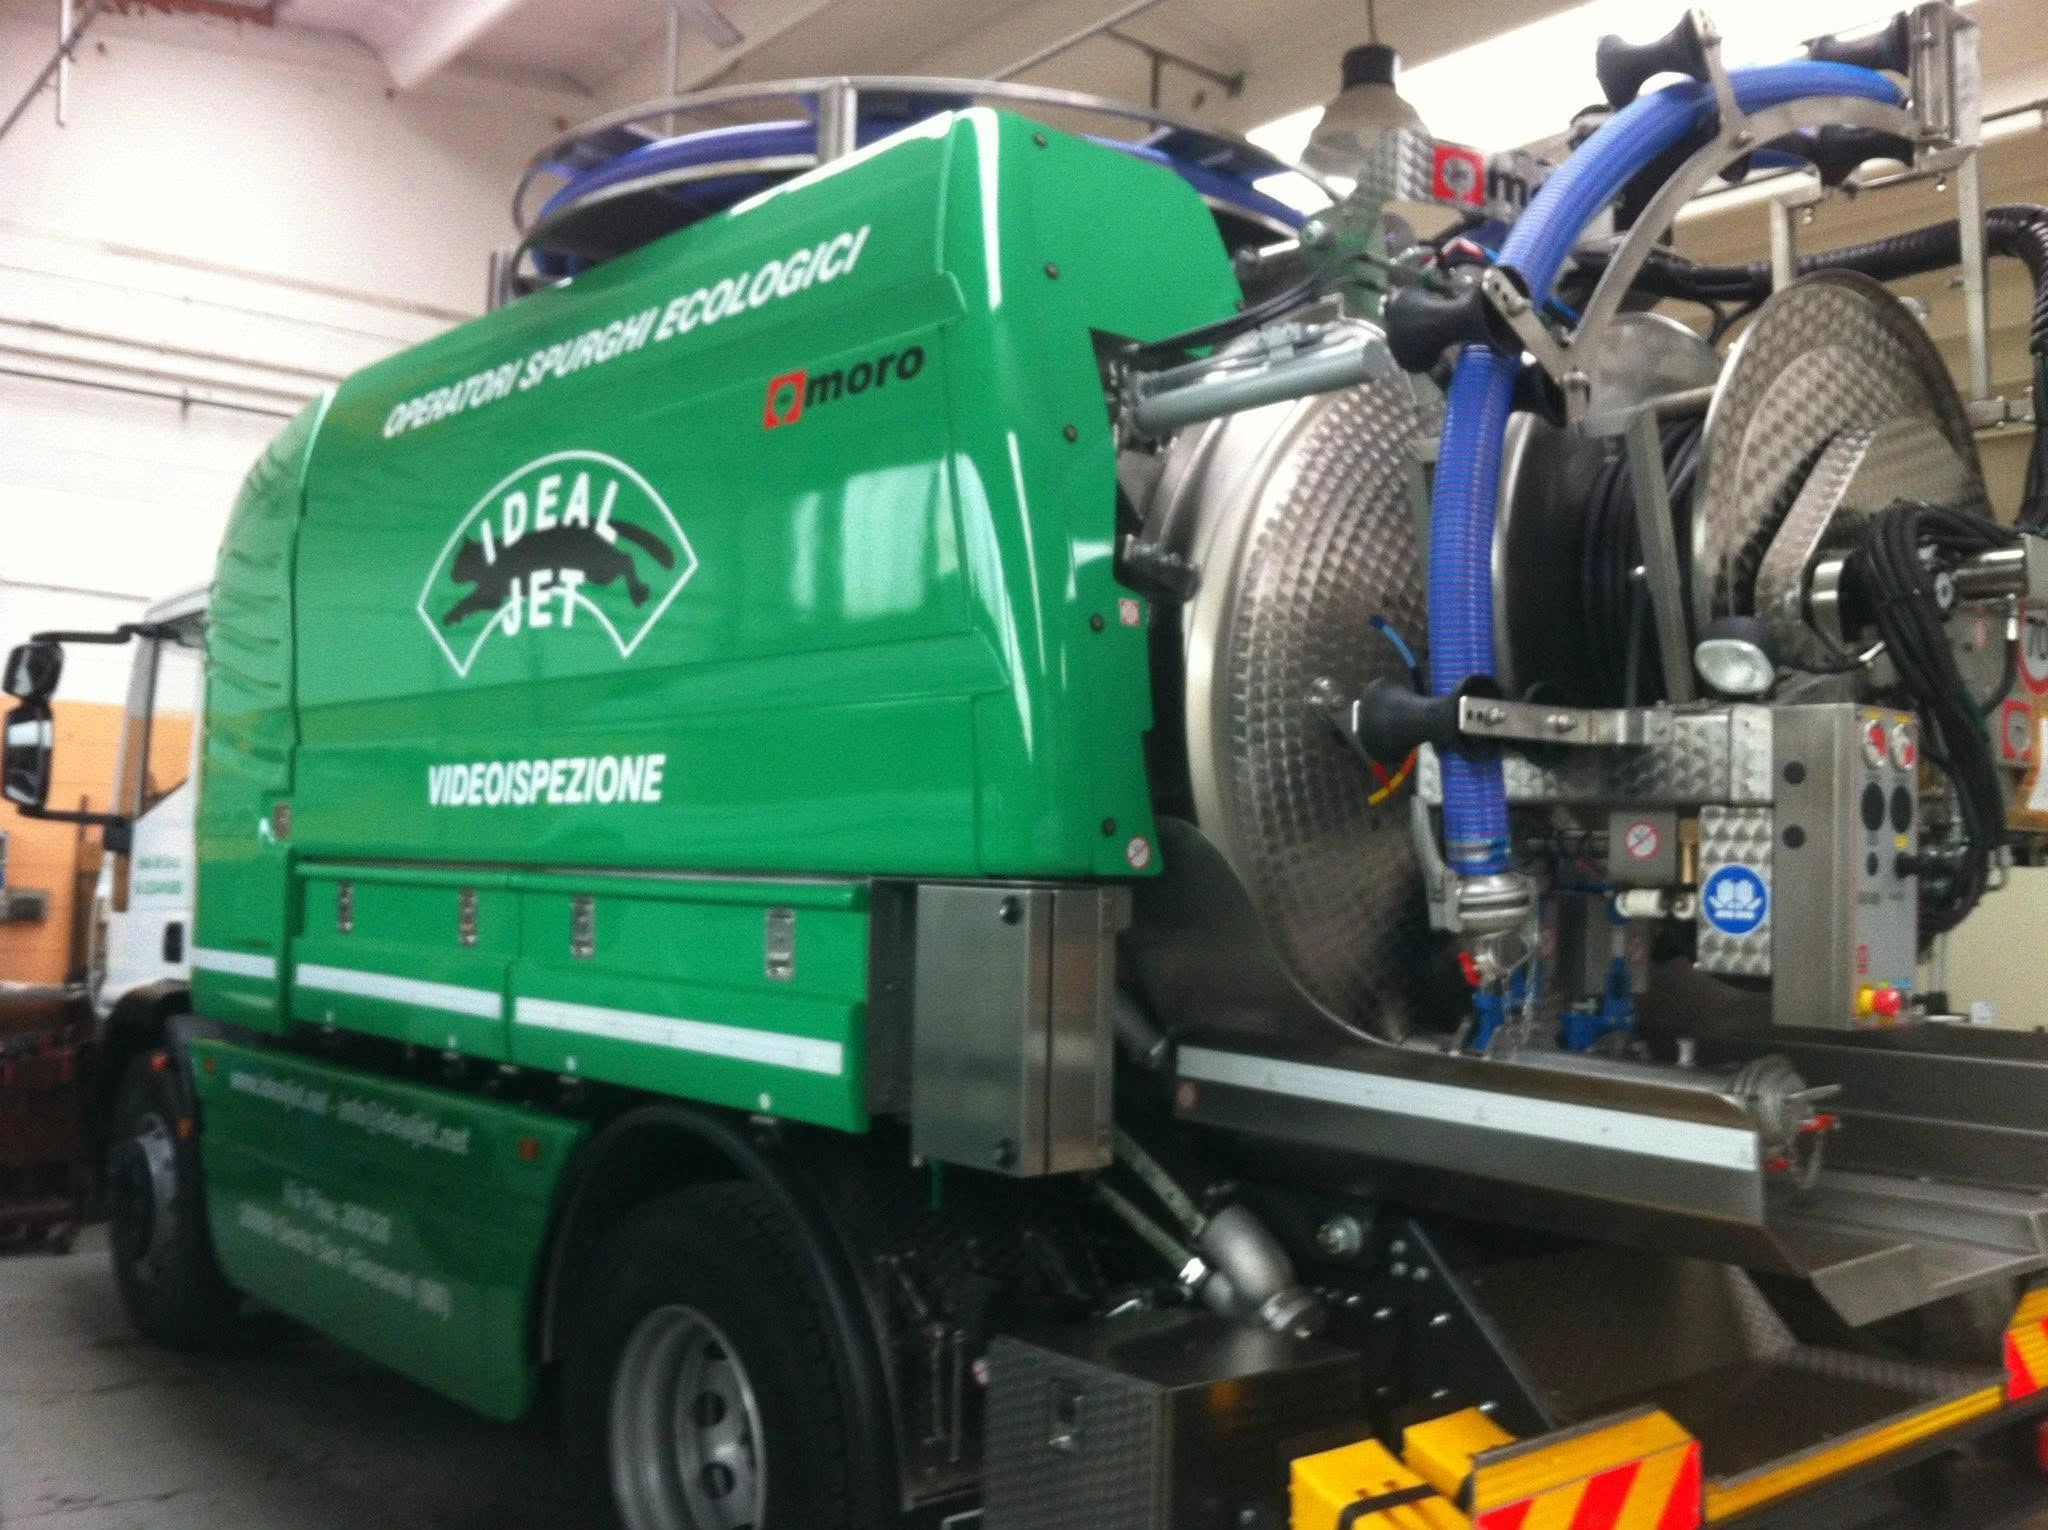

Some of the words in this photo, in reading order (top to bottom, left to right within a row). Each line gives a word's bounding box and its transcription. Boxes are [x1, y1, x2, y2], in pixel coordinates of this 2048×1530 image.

[383, 364, 518, 439] OPERATORI
[518, 308, 656, 391] SPURGHI
[653, 225, 871, 342] ECOLOGICI
[804, 345, 926, 409] moro
[480, 472, 619, 566] IDEAL
[500, 568, 587, 637] JET
[428, 752, 667, 806] VIDEOISPEZIONE
